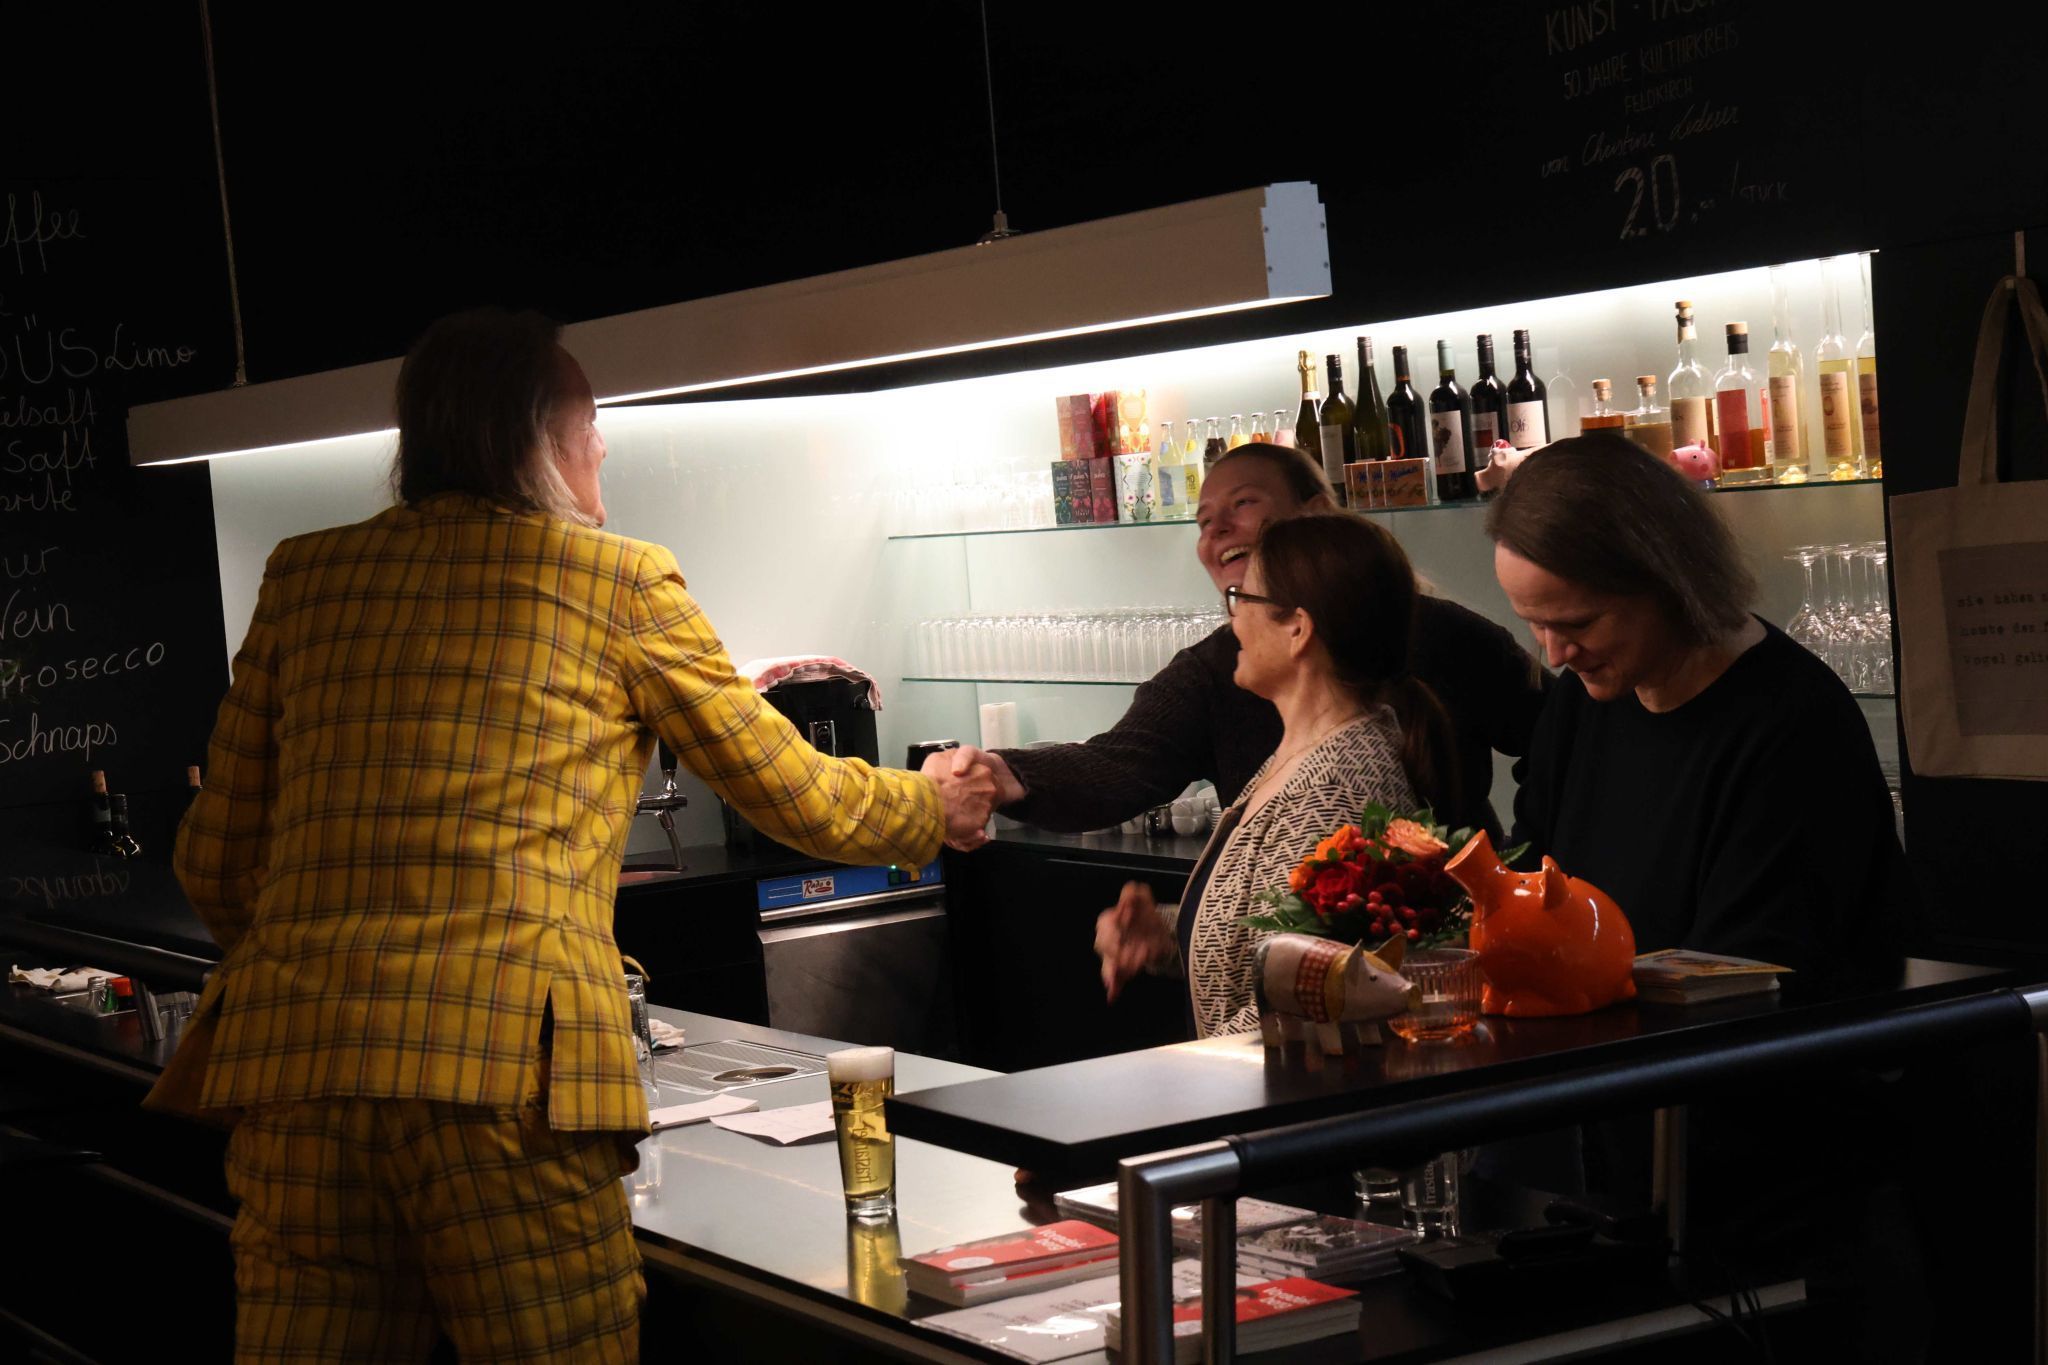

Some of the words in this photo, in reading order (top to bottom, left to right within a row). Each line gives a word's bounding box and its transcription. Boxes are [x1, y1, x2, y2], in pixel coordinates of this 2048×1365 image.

[1545, 0, 1617, 56] KUNST
[1584, 53, 1632, 96] JAHRE
[1640, 21, 1739, 73] KULTURKREIS
[1624, 75, 1694, 114] FELDKIRCH
[1541, 156, 1570, 179] von
[0, 190, 88, 275] ffee
[104, 322, 198, 371] Limo
[0, 386, 98, 442] elsaft
[2, 427, 97, 487] Saft
[0, 642, 165, 700] Prosecco
[0, 712, 117, 763] Schnaps
